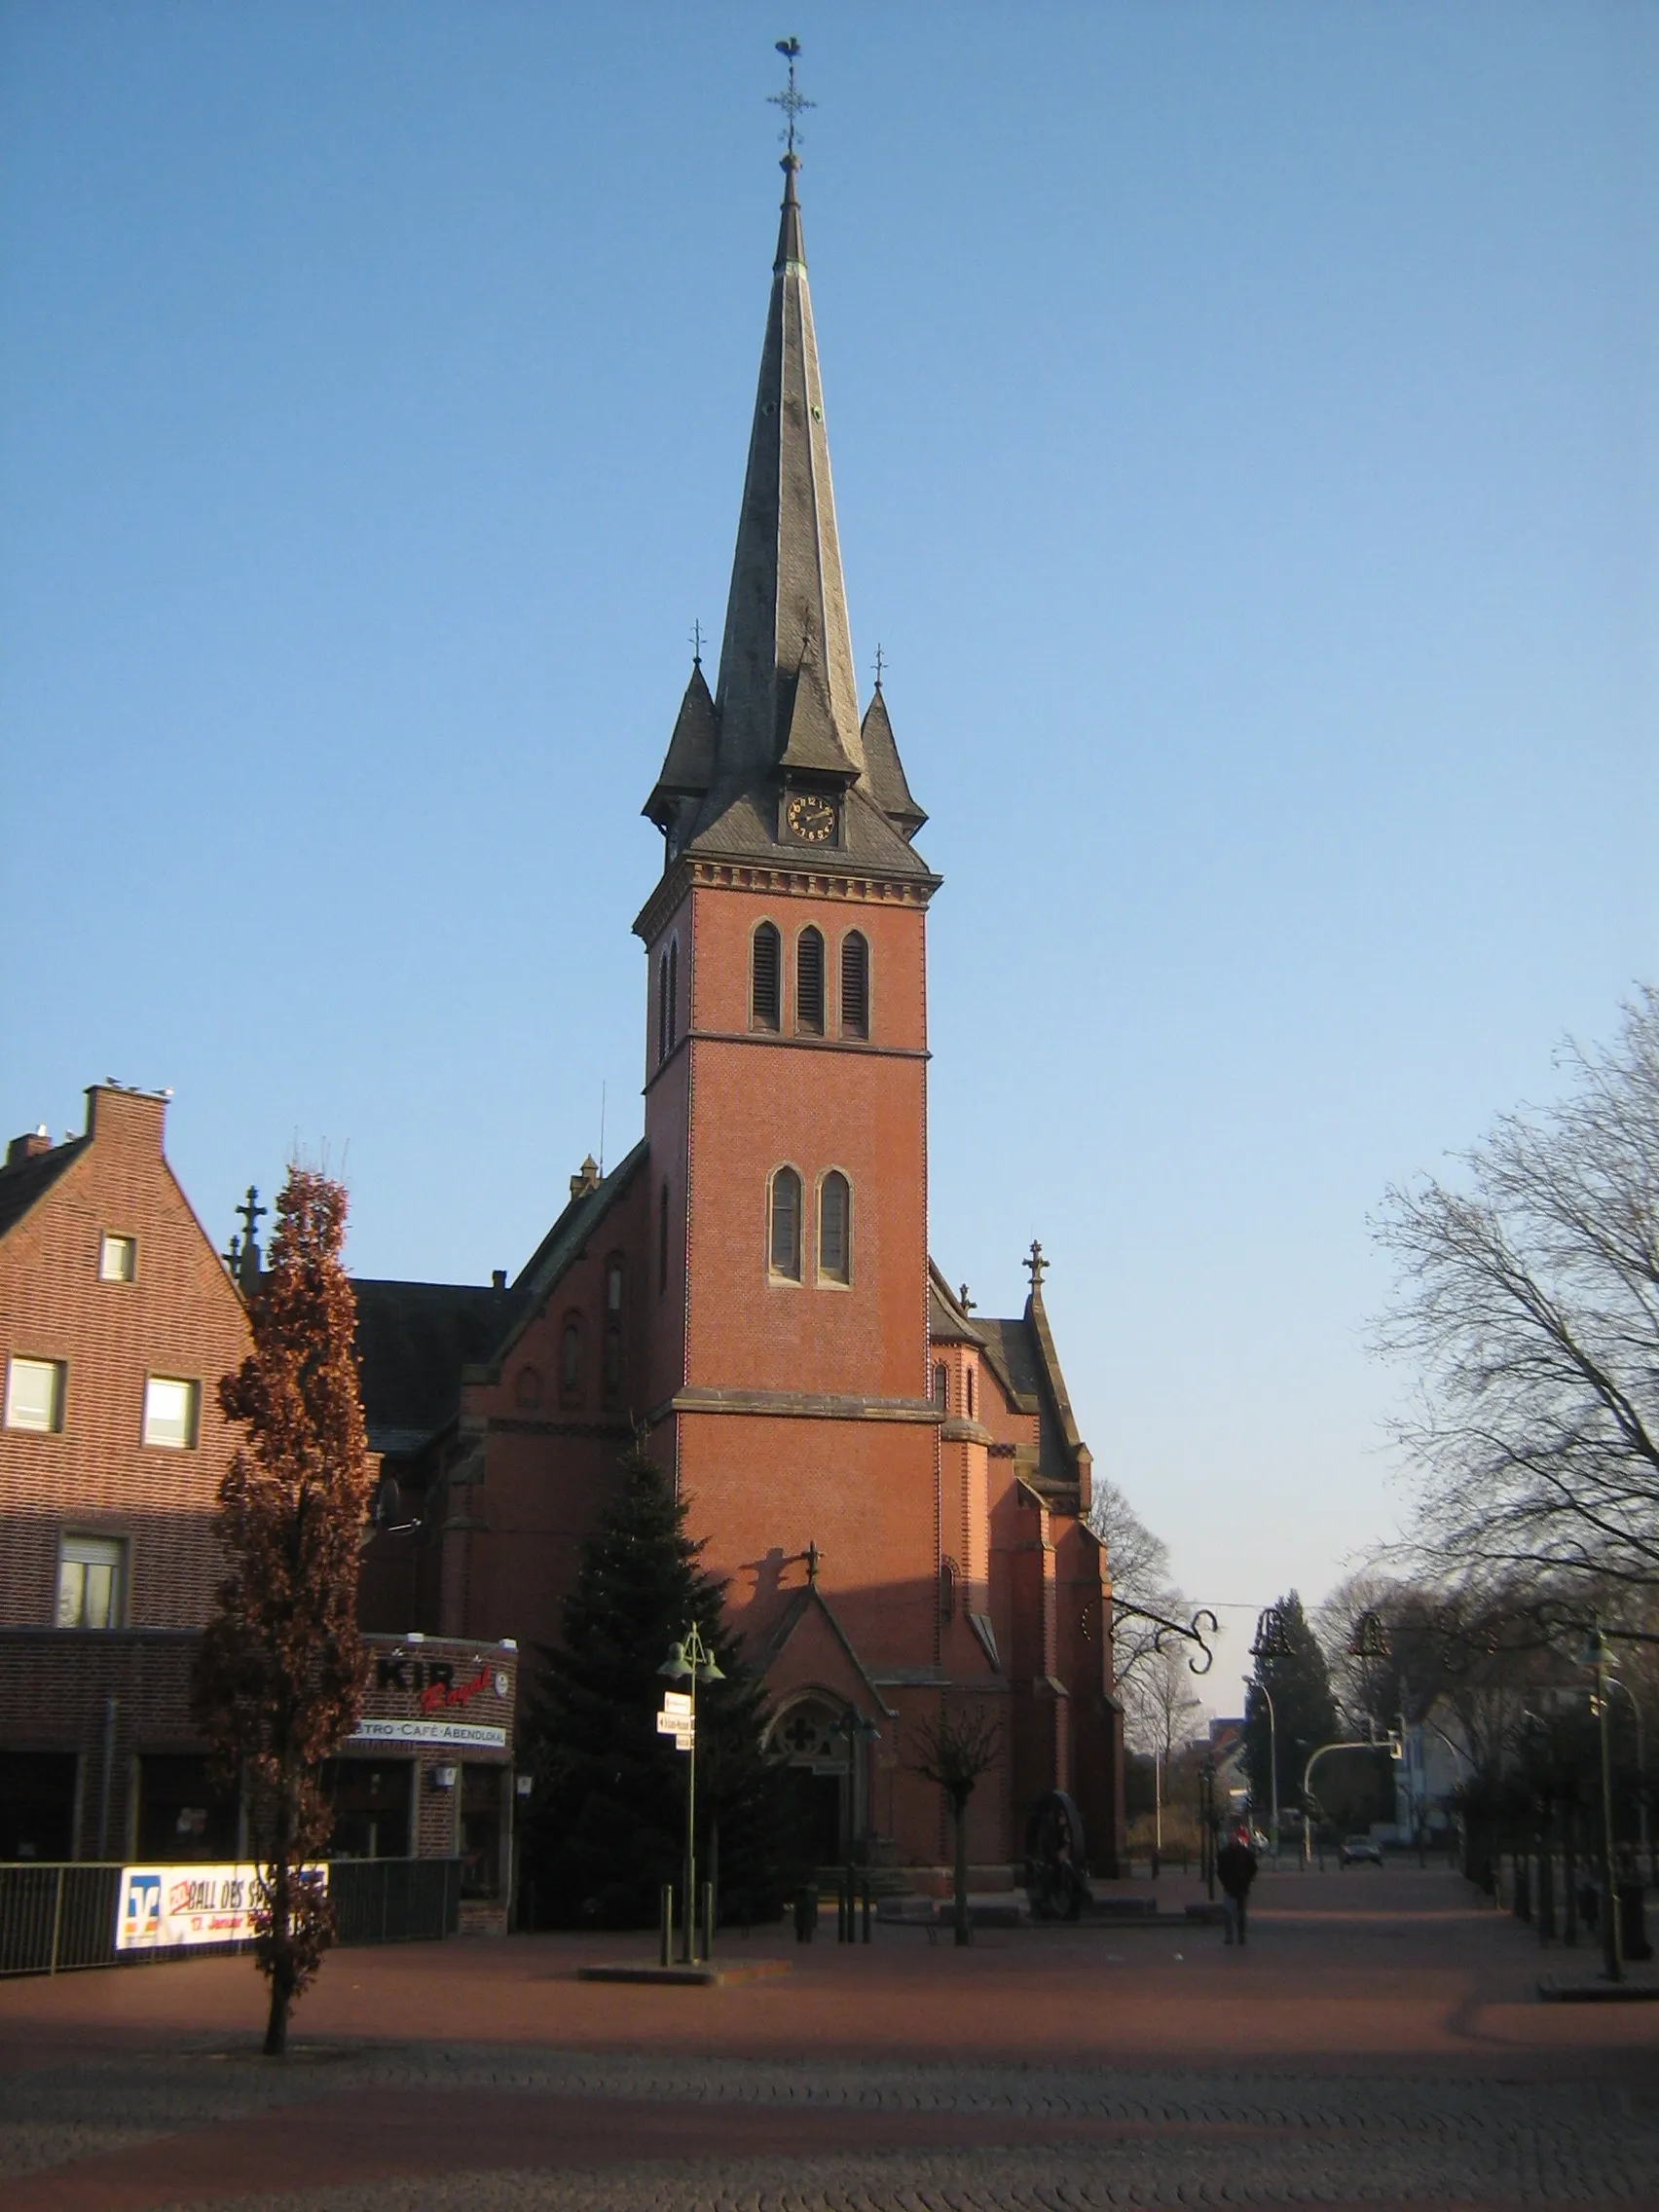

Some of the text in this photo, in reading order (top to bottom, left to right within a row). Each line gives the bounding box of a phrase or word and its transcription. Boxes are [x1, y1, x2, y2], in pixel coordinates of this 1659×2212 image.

[800, 798, 806, 807] 11
[807, 796, 816, 806] 12
[792, 802, 801, 812] 10
[790, 811, 795, 821] 9
[793, 821, 799, 830] 8
[800, 828, 806, 836] 7
[809, 832, 814, 840] 6
[817, 830, 823, 839] 5
[378, 1659, 455, 1690] KIR
[421, 1664, 492, 1714] Royal
[187, 1880, 216, 1910] BALL
[221, 1879, 244, 1909] DES
